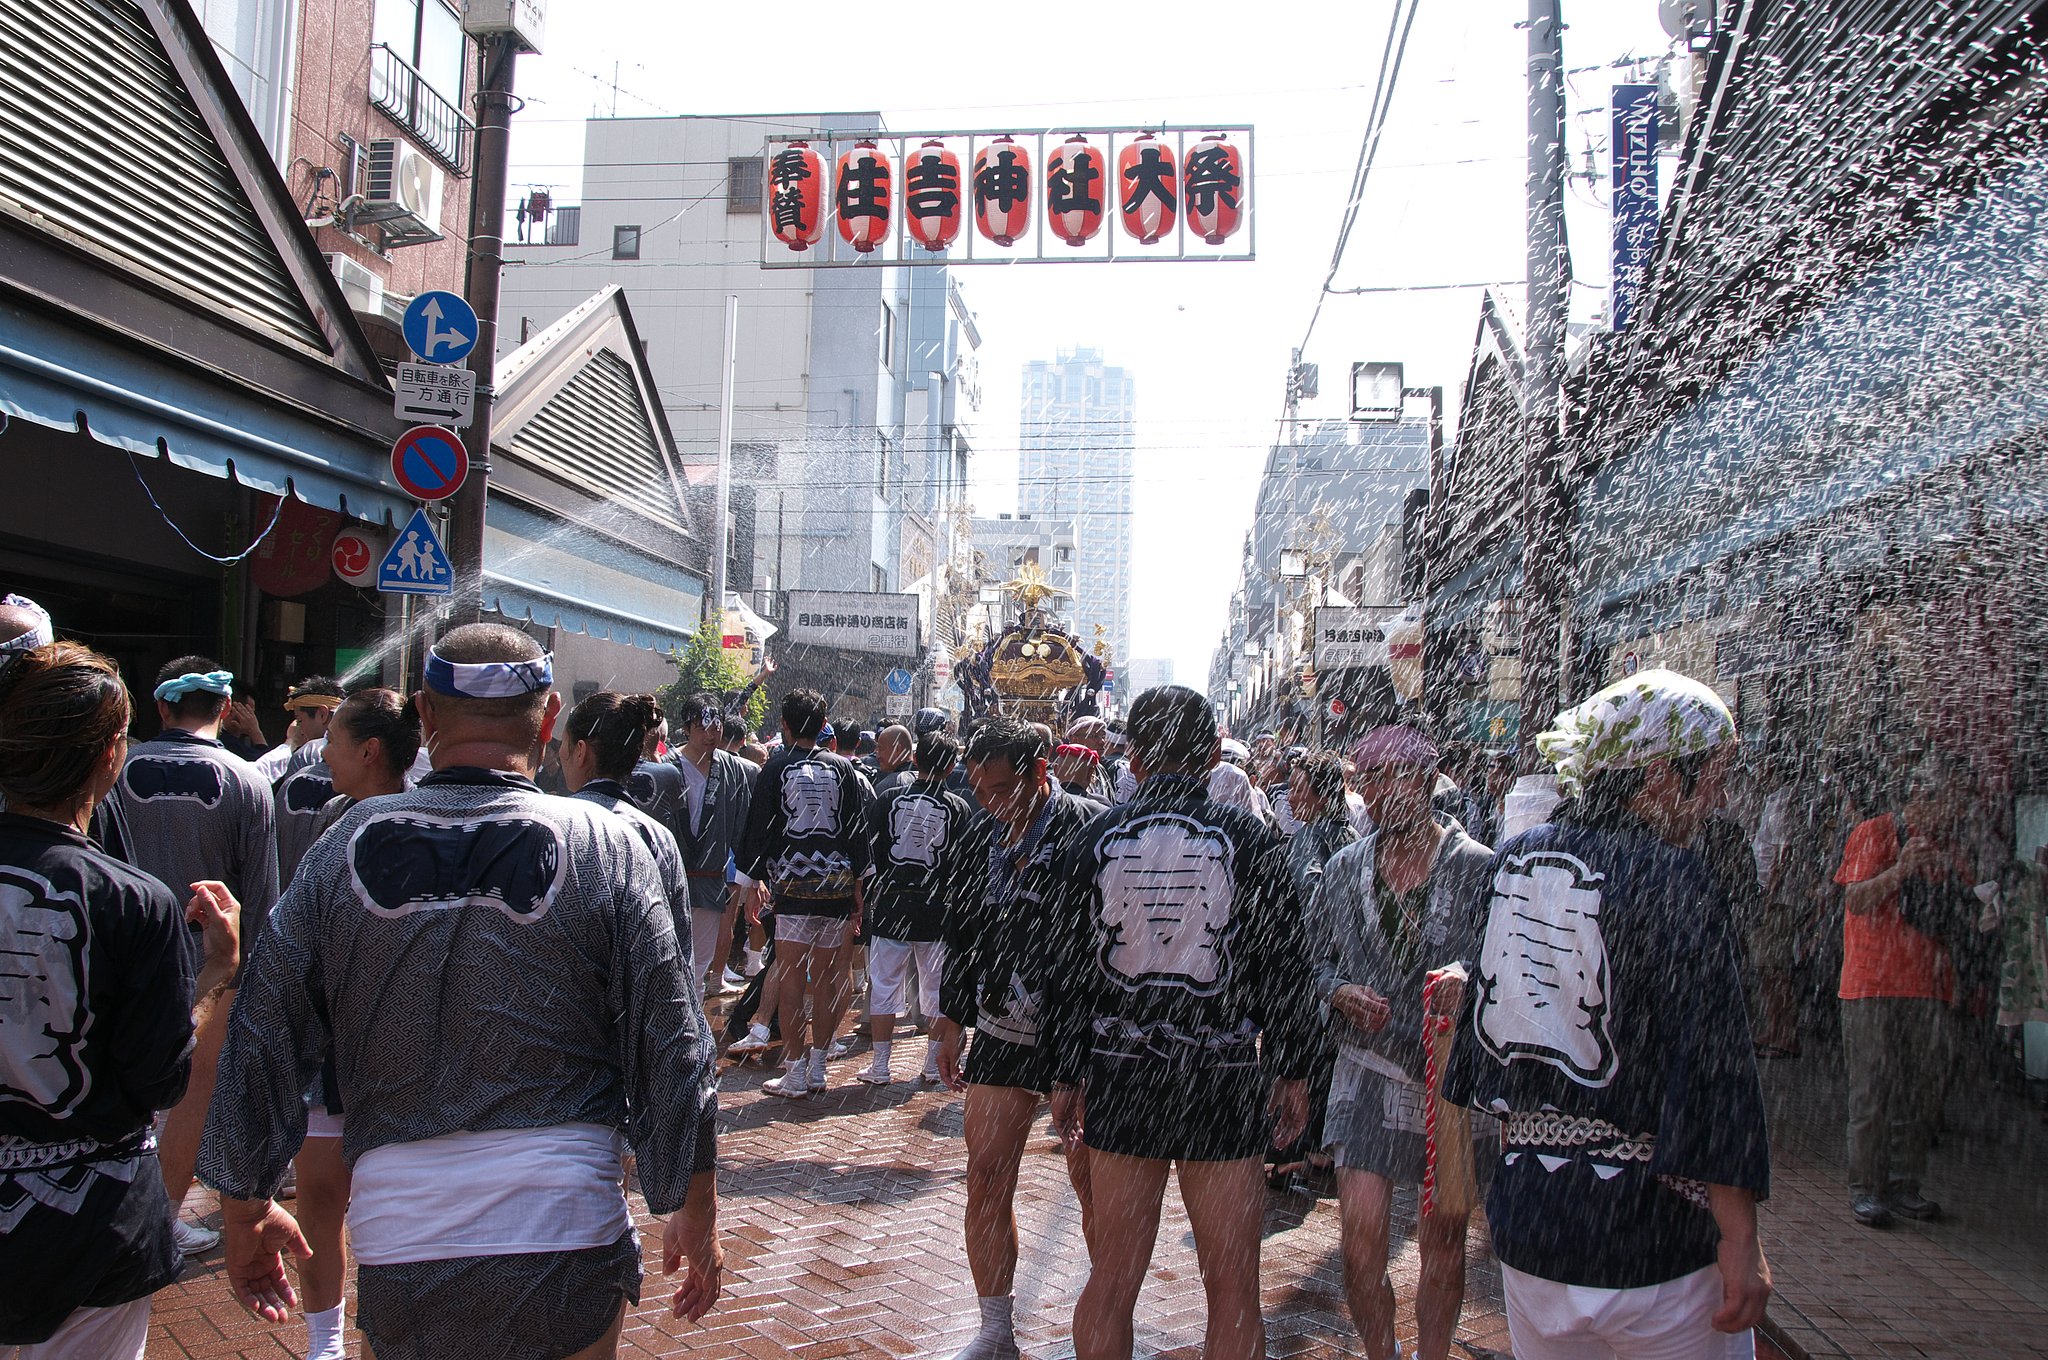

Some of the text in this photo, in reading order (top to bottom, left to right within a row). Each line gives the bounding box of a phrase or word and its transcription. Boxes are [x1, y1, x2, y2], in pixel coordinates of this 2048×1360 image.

[1630, 103, 1649, 197] MIZUHO
[770, 149, 812, 233] 奉賛
[401, 368, 471, 389] 自転車を除く
[401, 386, 470, 406] 一方通行
[798, 613, 909, 630] 月島西仲通り商店街
[868, 634, 908, 649] 2番街
